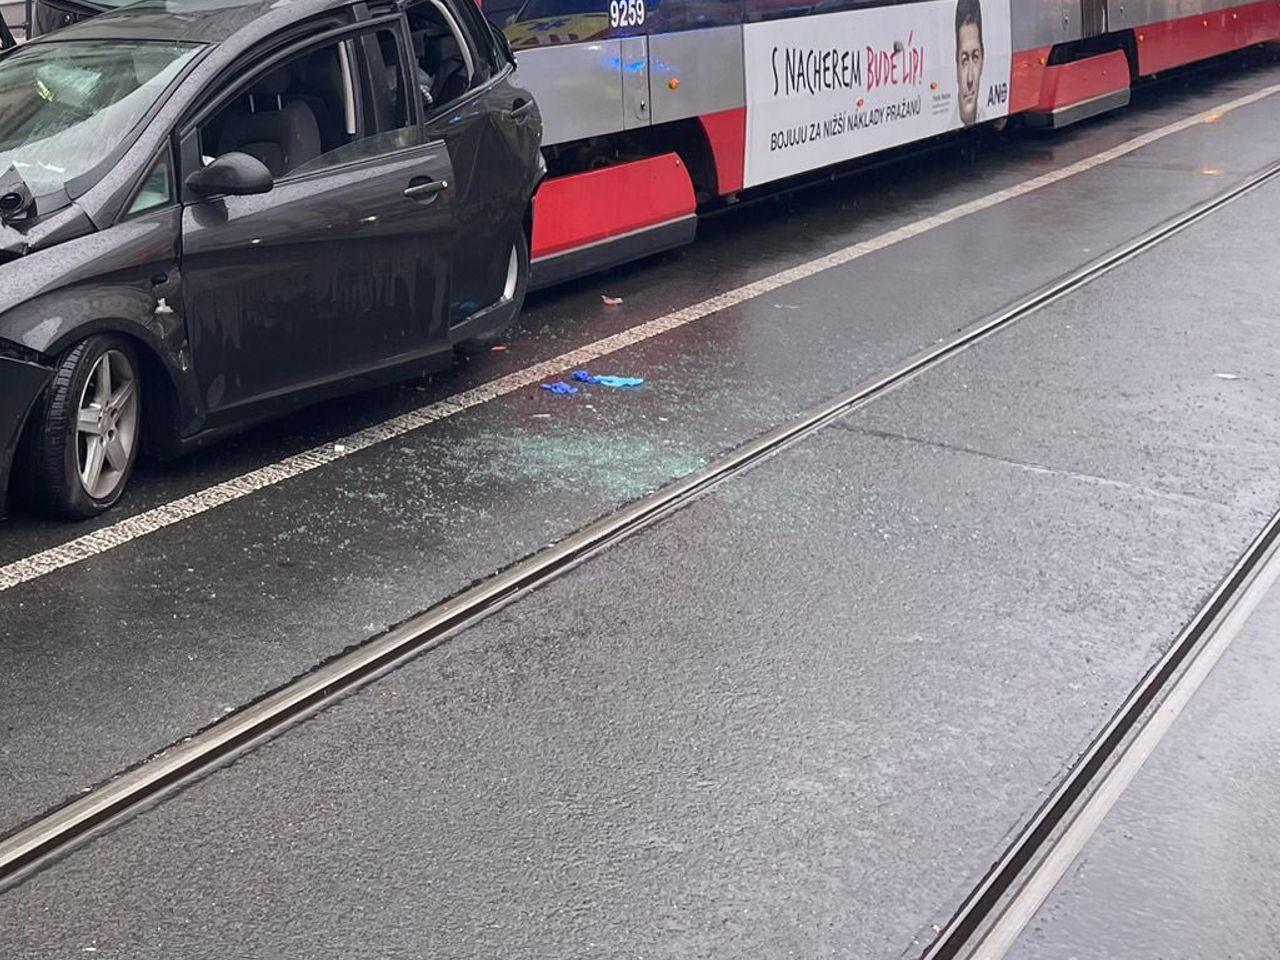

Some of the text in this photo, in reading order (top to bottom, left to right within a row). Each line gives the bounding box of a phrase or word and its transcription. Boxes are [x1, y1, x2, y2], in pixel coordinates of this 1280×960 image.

[772, 29, 924, 96] S NACHEREM BUDE LÍP!
[986, 82, 1008, 108] ANO
[770, 125, 808, 152] BOJUJU
[809, 122, 822, 142] ZA
[823, 110, 847, 139] NIŽŠÍ
[847, 106, 886, 132] NÁKLADY
